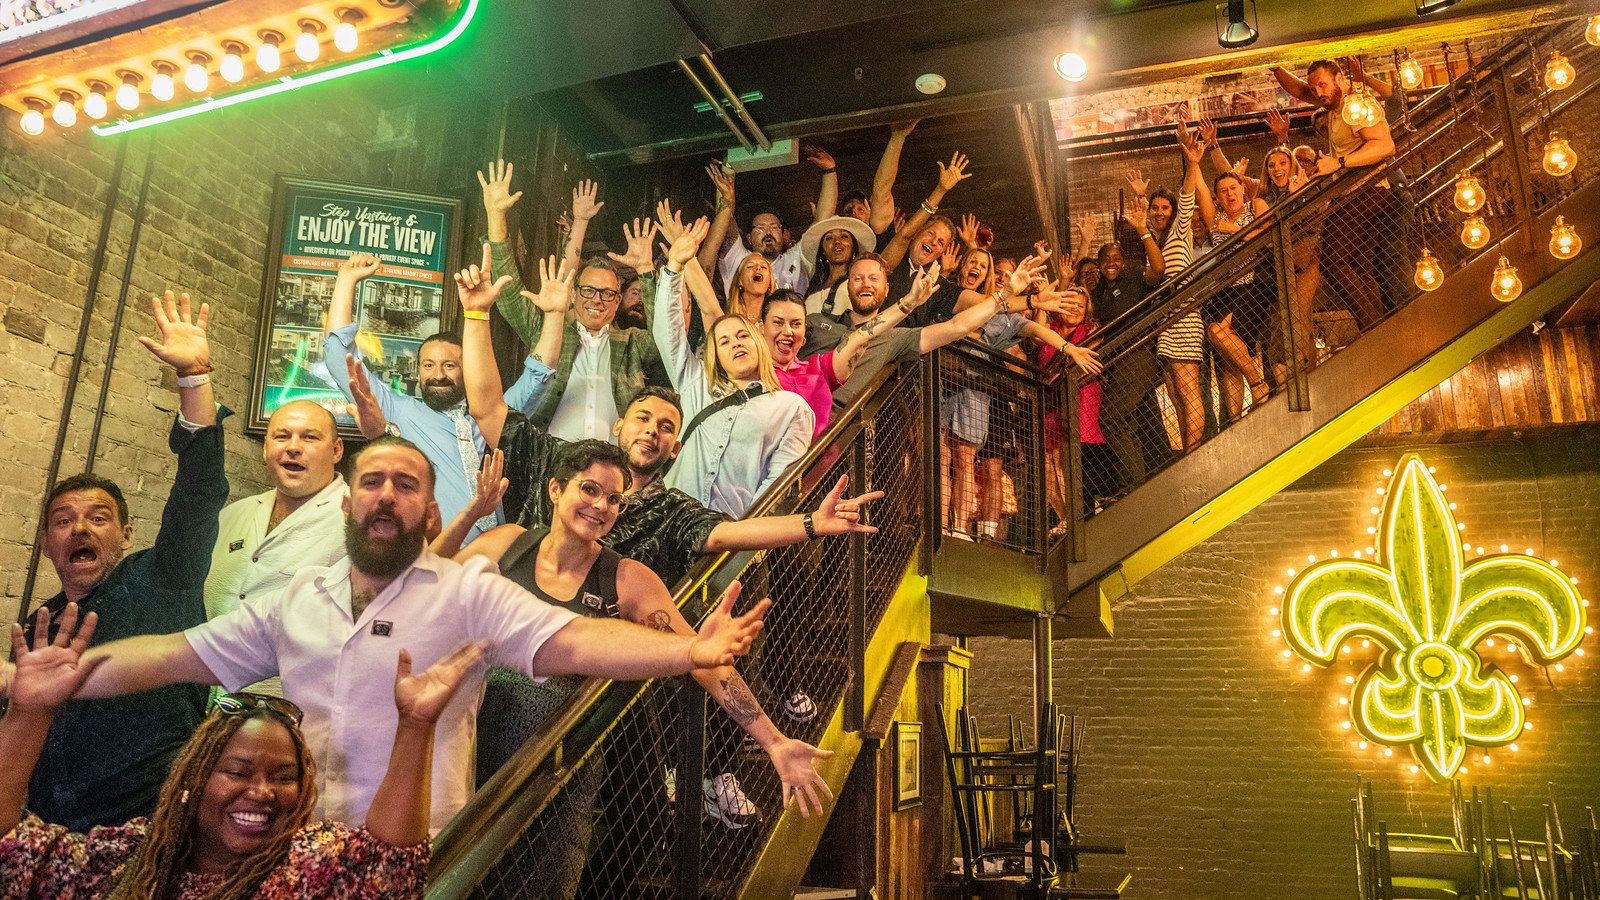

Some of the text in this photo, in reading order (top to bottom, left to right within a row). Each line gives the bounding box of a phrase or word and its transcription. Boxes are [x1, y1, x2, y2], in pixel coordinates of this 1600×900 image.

[319, 203, 419, 227] Step Upstairs &
[297, 215, 436, 255] ENJOY THE VIEW
